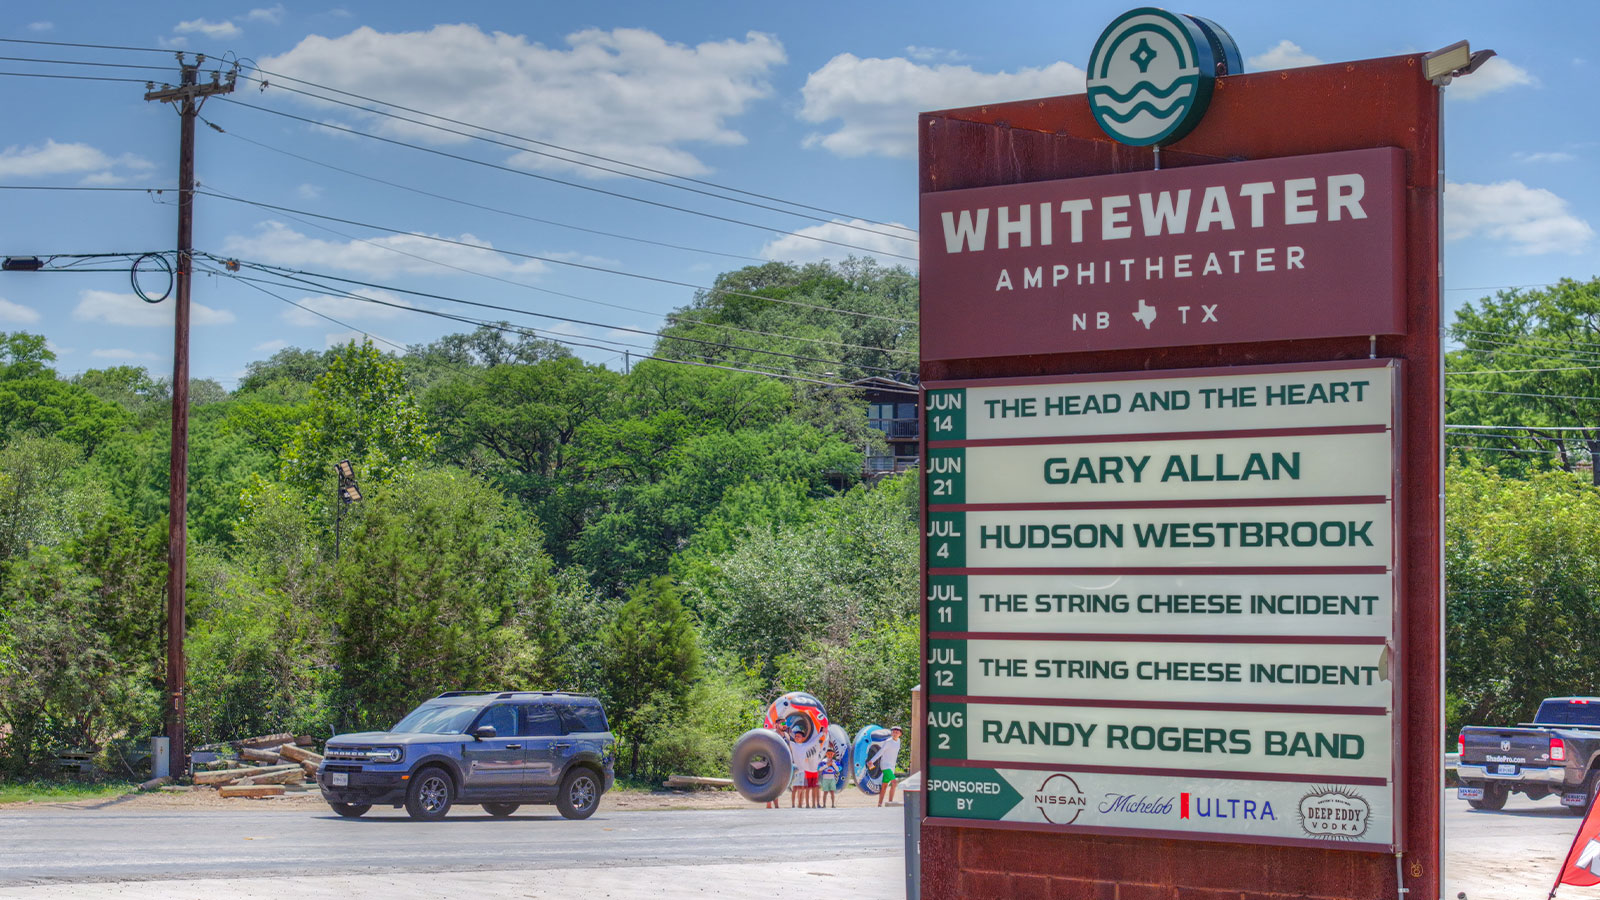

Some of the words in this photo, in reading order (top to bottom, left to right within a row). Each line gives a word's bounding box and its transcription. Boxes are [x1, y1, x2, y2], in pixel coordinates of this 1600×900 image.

[941, 173, 1368, 254] WHITEWATER
[995, 246, 1305, 291] AMPHITHEATER
[1073, 312, 1109, 330] NB
[1178, 304, 1217, 323] TX
[927, 394, 961, 410] JUN
[984, 398, 1037, 418] THE
[1045, 394, 1121, 416] HEAD
[1129, 390, 1190, 412] AND
[1199, 387, 1256, 408] THE
[1266, 381, 1369, 406] HEART
[934, 416, 952, 431] 14
[927, 457, 960, 473] JUN
[1044, 456, 1151, 484] GARY
[1161, 452, 1300, 482] ALLAN
[934, 479, 951, 495] 21
[927, 521, 960, 536] JUL
[981, 524, 1123, 548] HUDSON
[1133, 521, 1373, 547] WESTBROOK
[937, 543, 949, 558] 4
[928, 585, 962, 600] JUL
[979, 595, 1028, 612] THE
[1036, 595, 1129, 613] STRING
[1137, 595, 1242, 613] CHEESE
[1251, 595, 1379, 615] INCIDENT
[938, 607, 951, 622] 11
[928, 649, 962, 664] JUL
[935, 671, 953, 686] 12
[979, 659, 1027, 677] THE
[1035, 660, 1128, 679] STRING
[1137, 662, 1241, 682] CHEESE
[1250, 664, 1380, 685] INCIDENT
[928, 712, 963, 727] AUG
[939, 734, 950, 749] 2
[983, 720, 1097, 747] RANDY
[1107, 725, 1251, 754] ROGERS
[1265, 731, 1364, 759] BAND
[928, 780, 1000, 794] SPONSORED
[957, 798, 973, 810] BY
[1035, 795, 1086, 805] NISSAN
[1098, 793, 1174, 814] Michelob
[1196, 797, 1275, 820] ULTRA
[1308, 807, 1332, 820] DEEP
[1336, 809, 1361, 821] EDDY
[1312, 822, 1358, 831] VODKA
